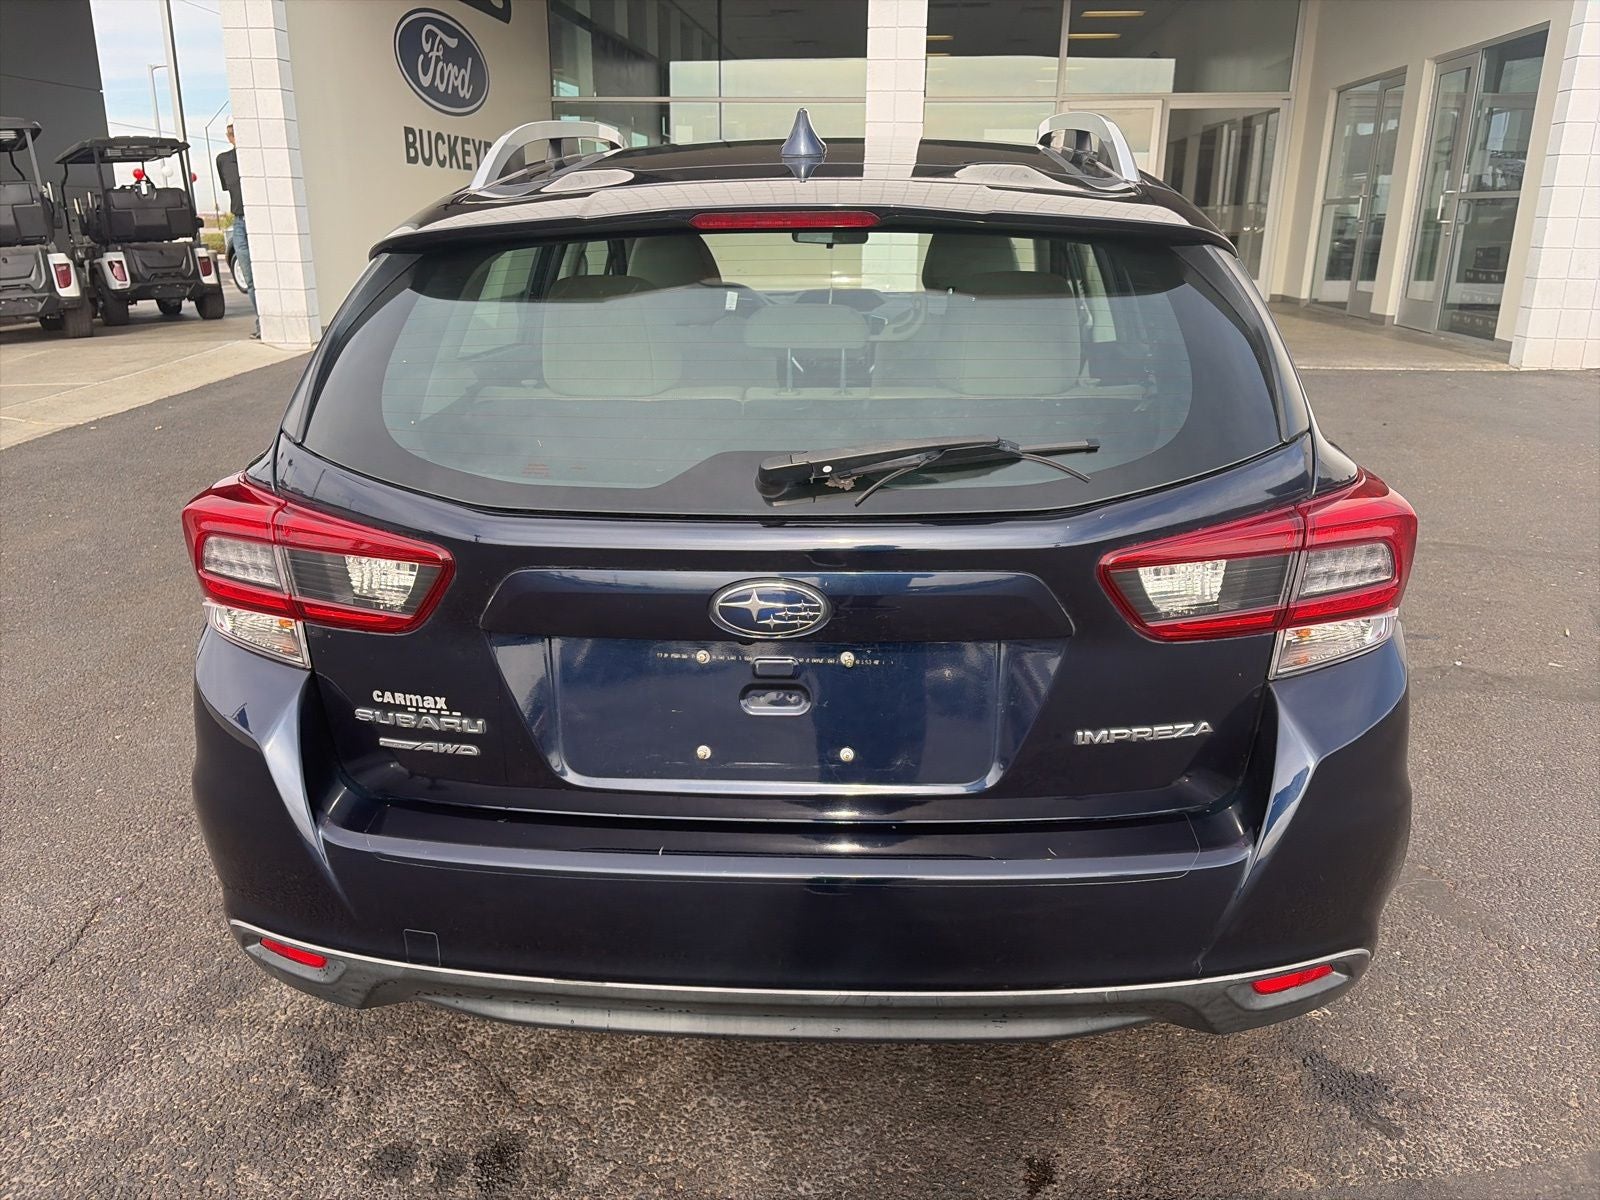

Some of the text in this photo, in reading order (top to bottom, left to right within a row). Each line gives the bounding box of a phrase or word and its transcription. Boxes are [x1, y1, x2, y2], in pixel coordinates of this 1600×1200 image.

[417, 24, 473, 100] Ford
[354, 707, 487, 734] SUBARU
[1074, 721, 1215, 745] IMPREZA
[415, 742, 480, 756] AWD
